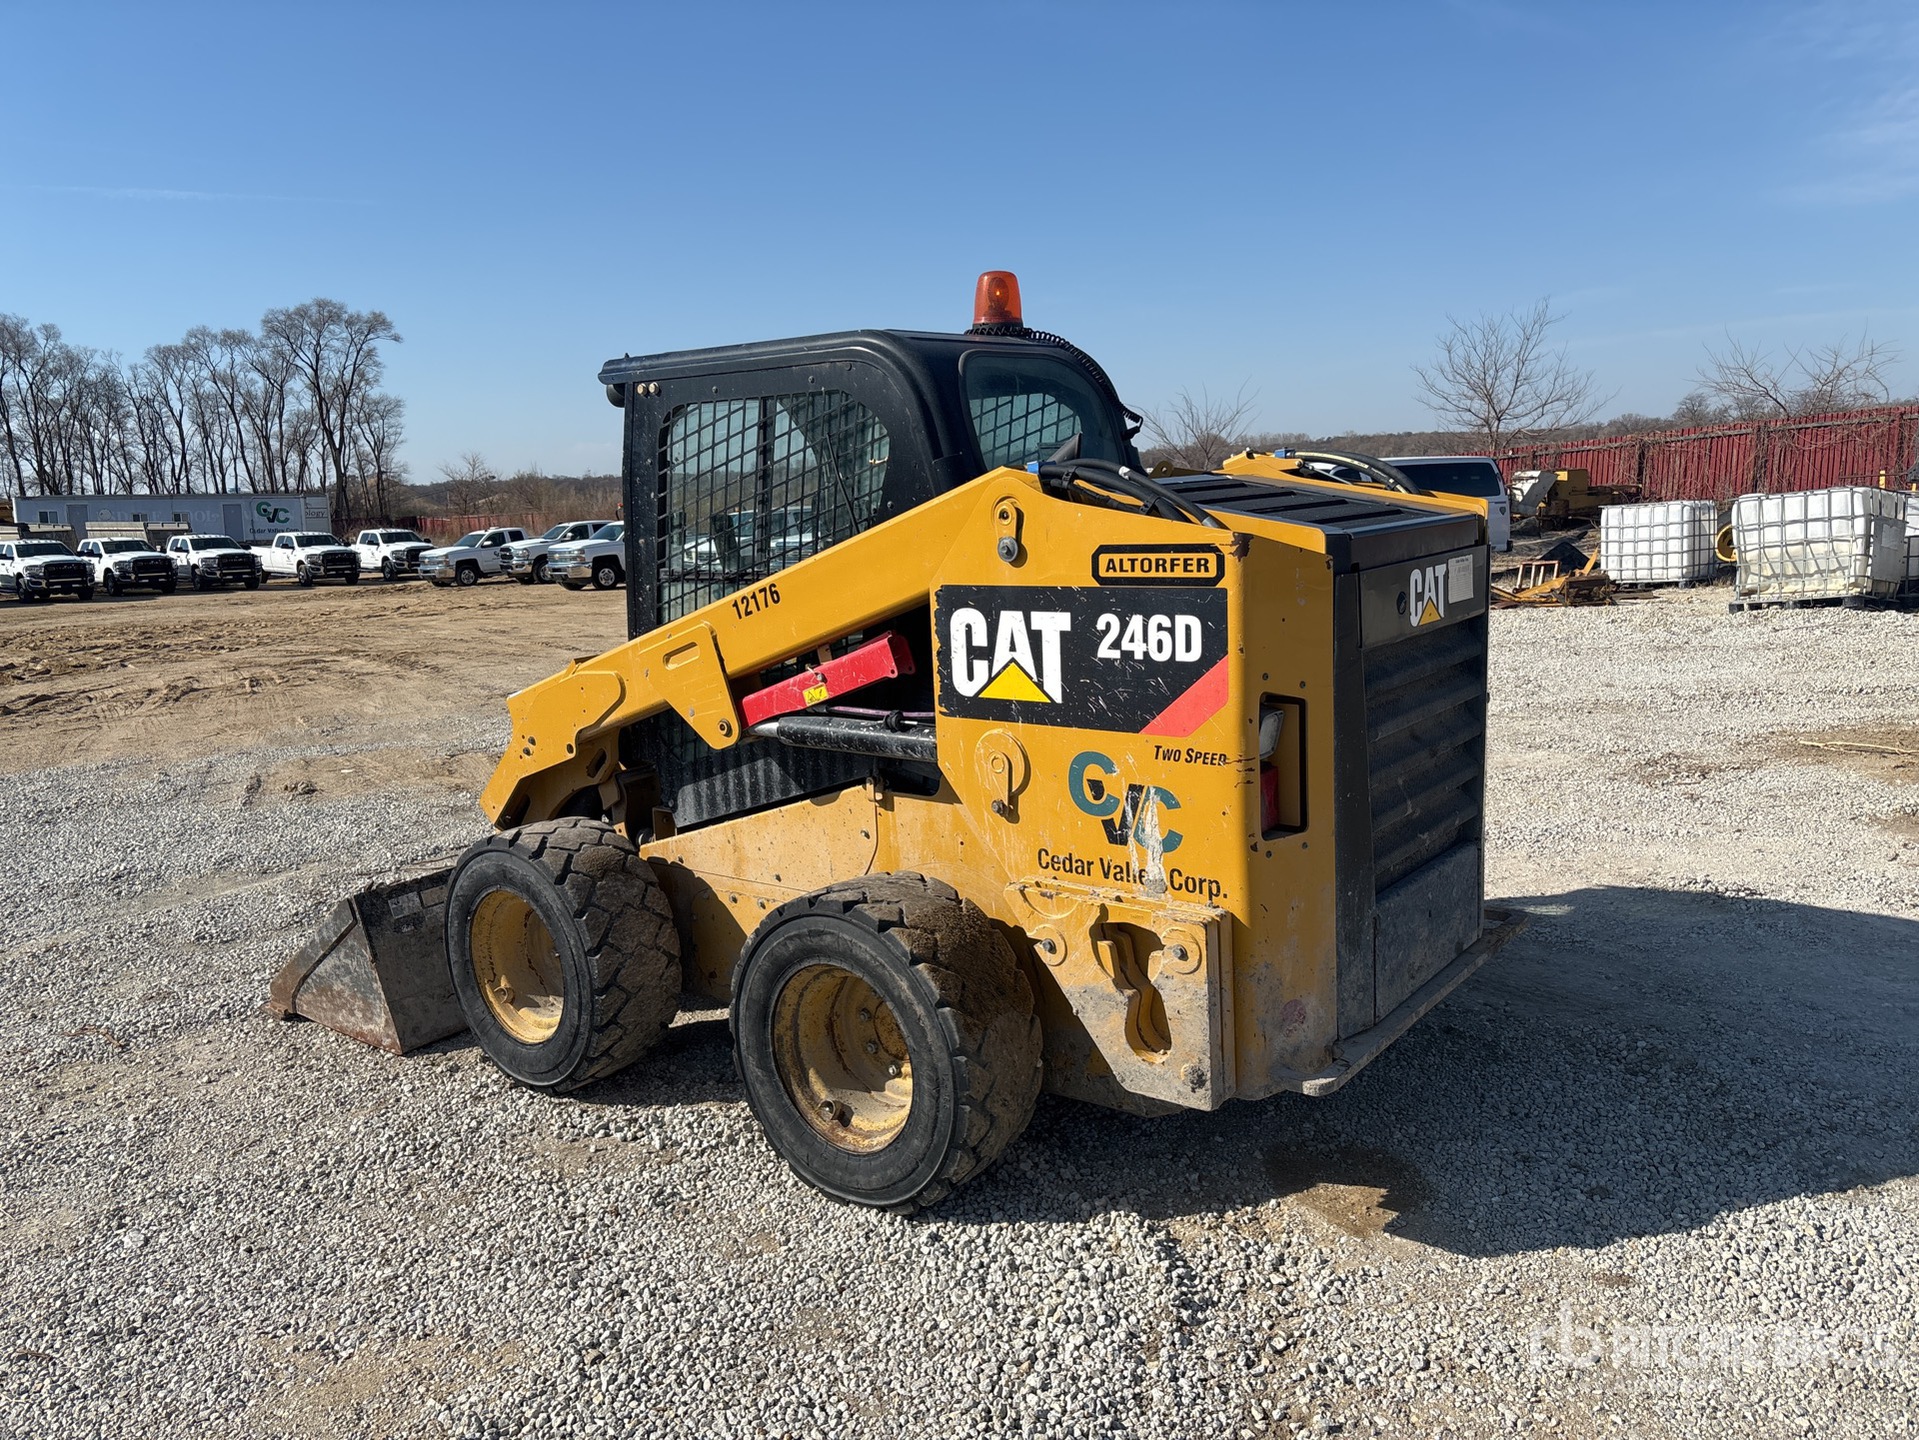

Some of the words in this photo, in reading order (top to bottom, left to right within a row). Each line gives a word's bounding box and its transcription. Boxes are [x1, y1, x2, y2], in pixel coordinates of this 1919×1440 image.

[256, 501, 290, 523] CVC
[1105, 557, 1211, 574] ALTORFER
[732, 583, 781, 620] 12176
[1409, 563, 1447, 627] CAT
[950, 608, 1072, 704] CAT
[1096, 613, 1203, 662] 246D
[1068, 751, 1183, 853] CVC
[1037, 848, 1094, 877] Cedar
[1099, 857, 1157, 887] Valle
[1169, 868, 1229, 903] Corp.
